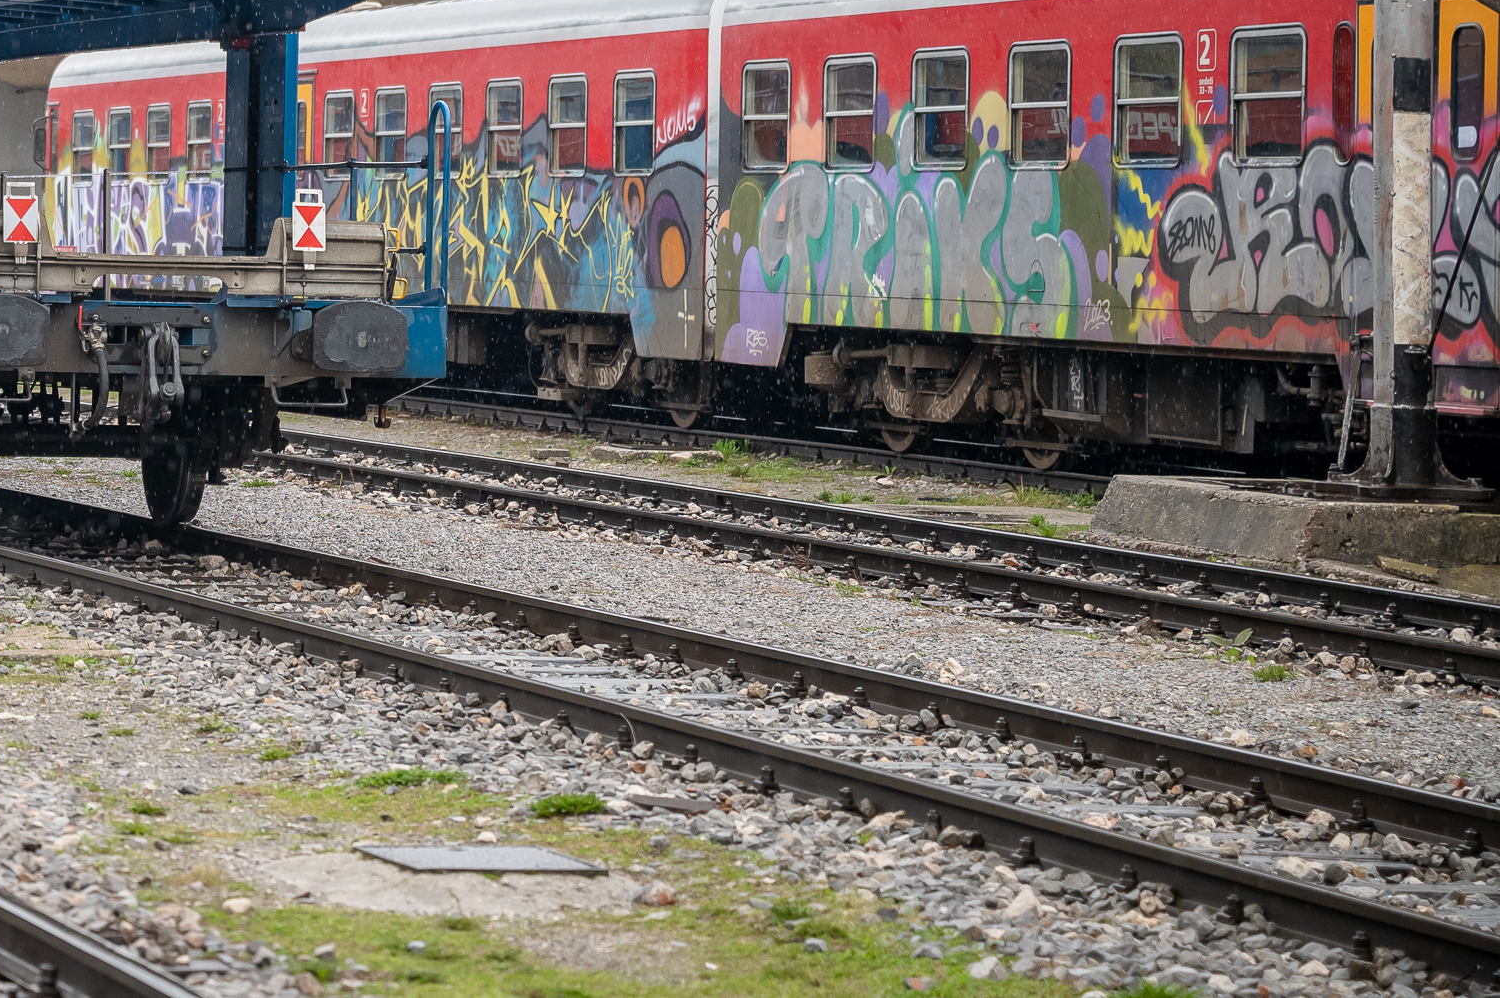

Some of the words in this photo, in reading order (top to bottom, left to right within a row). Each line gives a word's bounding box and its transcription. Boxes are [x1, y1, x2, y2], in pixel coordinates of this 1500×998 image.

[1199, 33, 1211, 66] 2
[218, 102, 223, 122] 2
[361, 92, 367, 114] 2
